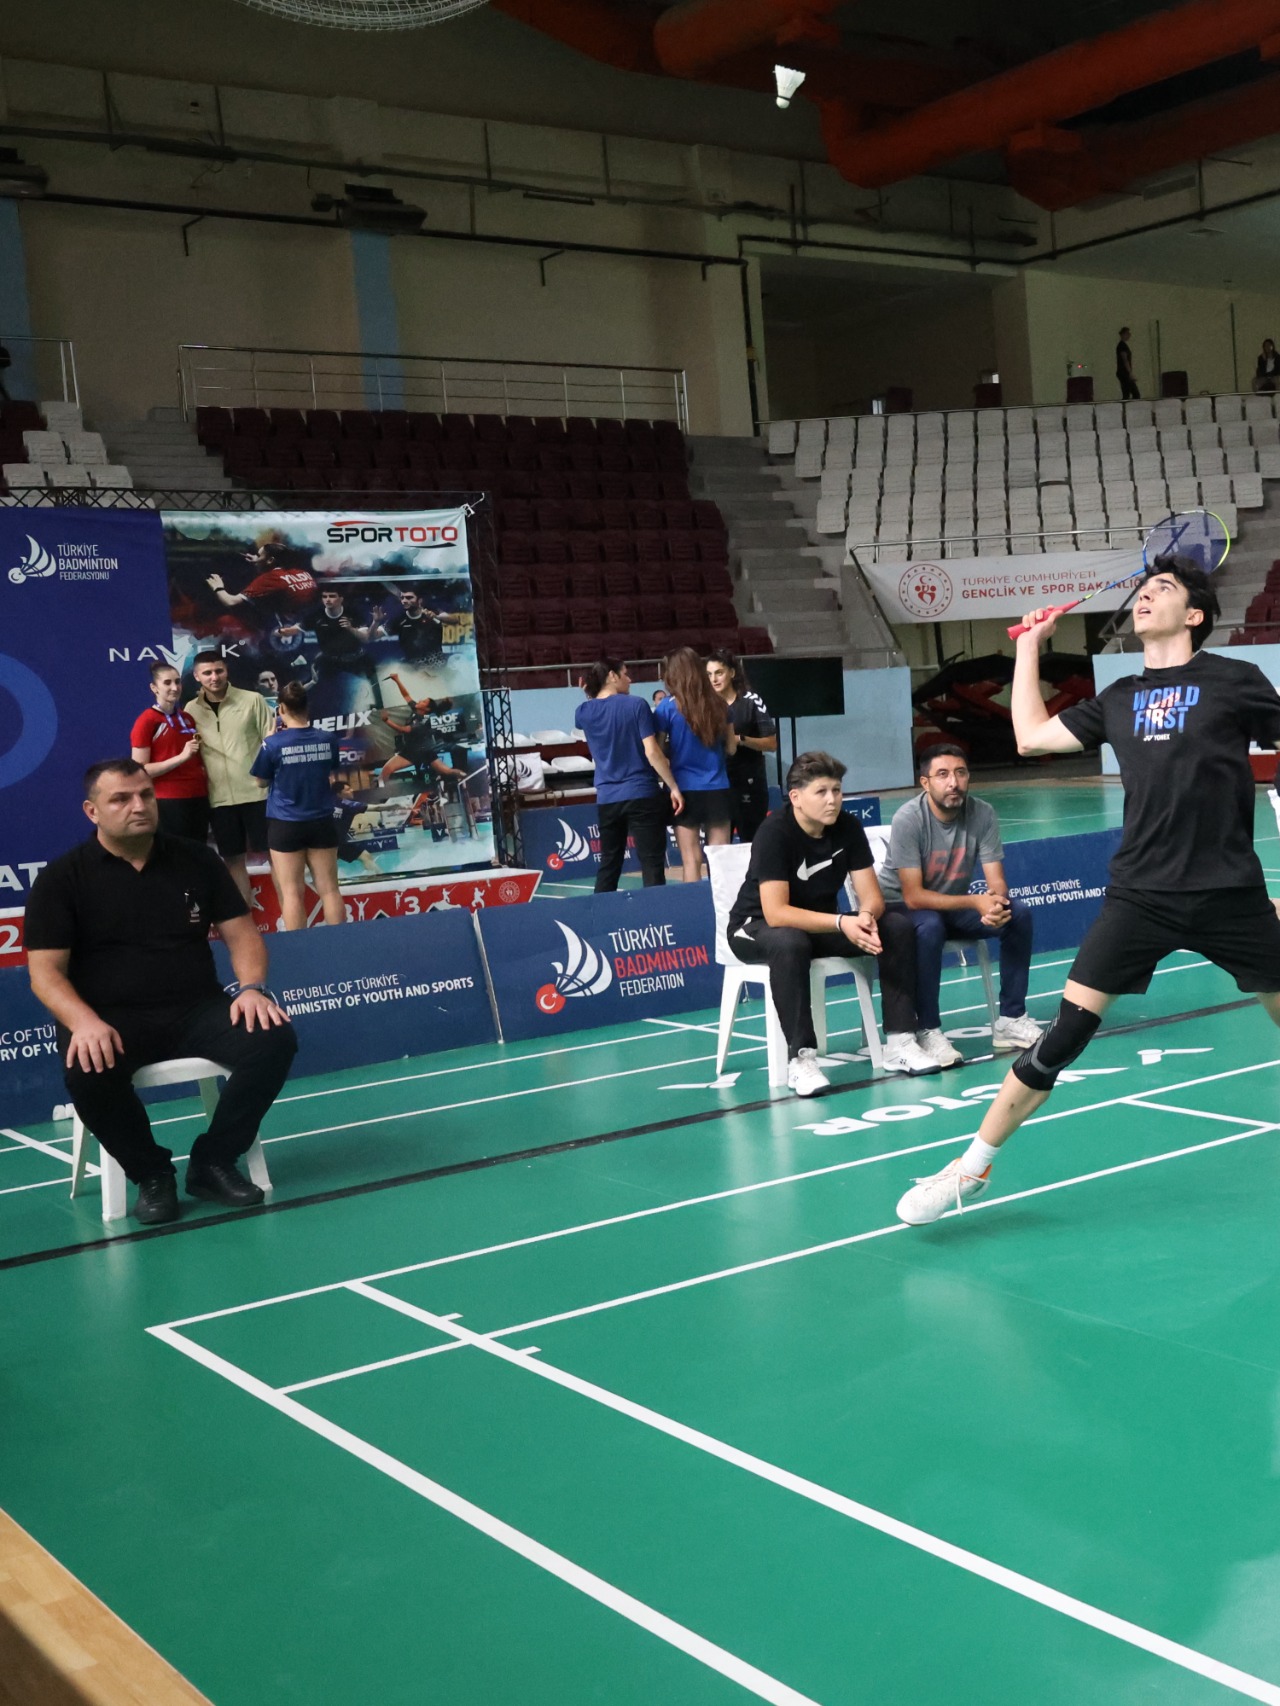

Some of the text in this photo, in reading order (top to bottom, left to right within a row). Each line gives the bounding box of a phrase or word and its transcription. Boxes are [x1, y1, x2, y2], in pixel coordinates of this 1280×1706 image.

[57, 542, 99, 556] TÜRKİYE
[58, 557, 118, 570] BADMİNTON
[60, 571, 110, 581] FEDERASYONU
[961, 585, 1016, 600] GENÇLİK
[1019, 585, 1035, 595] VE
[1041, 583, 1074, 594] SPOR
[1132, 685, 1200, 711] WORLD
[1133, 706, 1189, 737] FIRST
[1153, 733, 1170, 741] YONEX
[1041, 883, 1051, 893] OF
[1046, 894, 1057, 904] OF
[1057, 890, 1084, 902] YOUTH
[1085, 887, 1101, 898] AND
[404, 896, 421, 915] 3
[608, 923, 676, 953] TÜRKİYE
[613, 944, 709, 978] BADMİNTON
[282, 973, 399, 1002] REPUBLIC OF TÜRKİYE
[619, 972, 685, 998] FEDERATION
[285, 976, 474, 1017] MINISTRY OF YOUTH AND SPORTS
[13, 1028, 33, 1043] OF
[21, 1044, 41, 1058] OF
